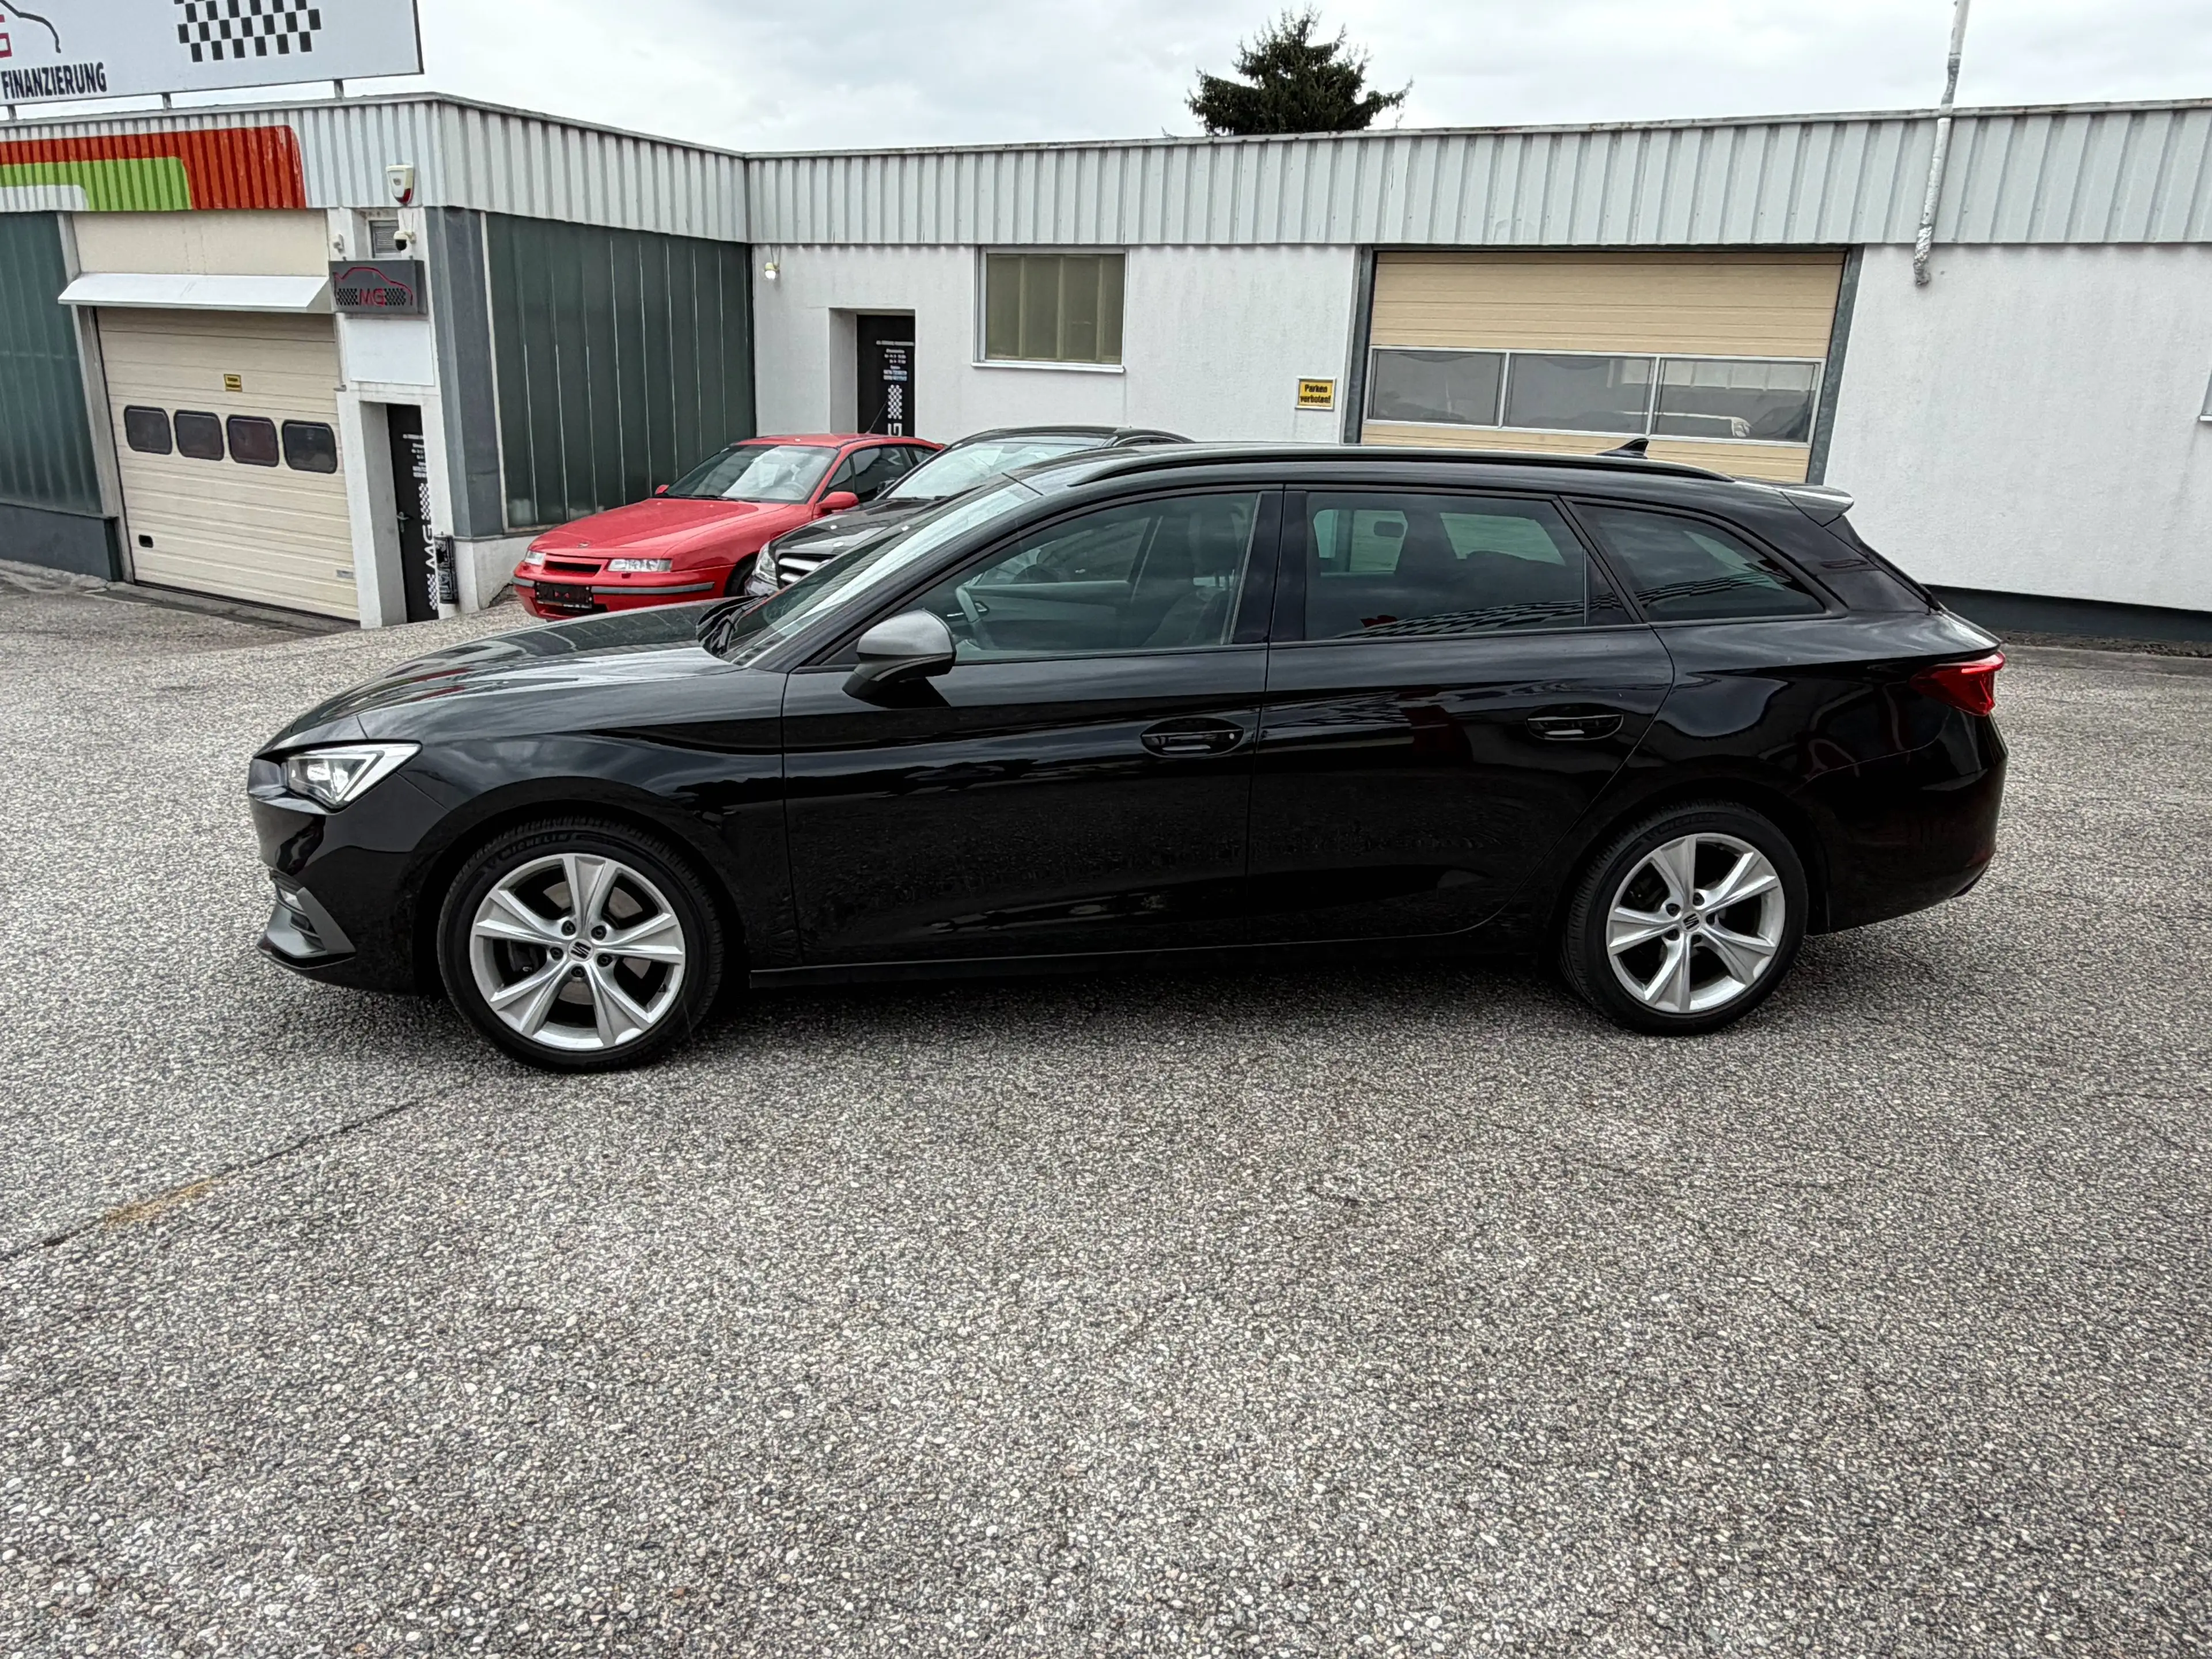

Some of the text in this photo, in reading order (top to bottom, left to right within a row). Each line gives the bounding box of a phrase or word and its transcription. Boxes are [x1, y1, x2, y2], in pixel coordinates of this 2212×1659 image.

[1, 62, 107, 100] FINANZIERUNG
[359, 287, 385, 306] MG
[1304, 384, 1328, 393] Parken
